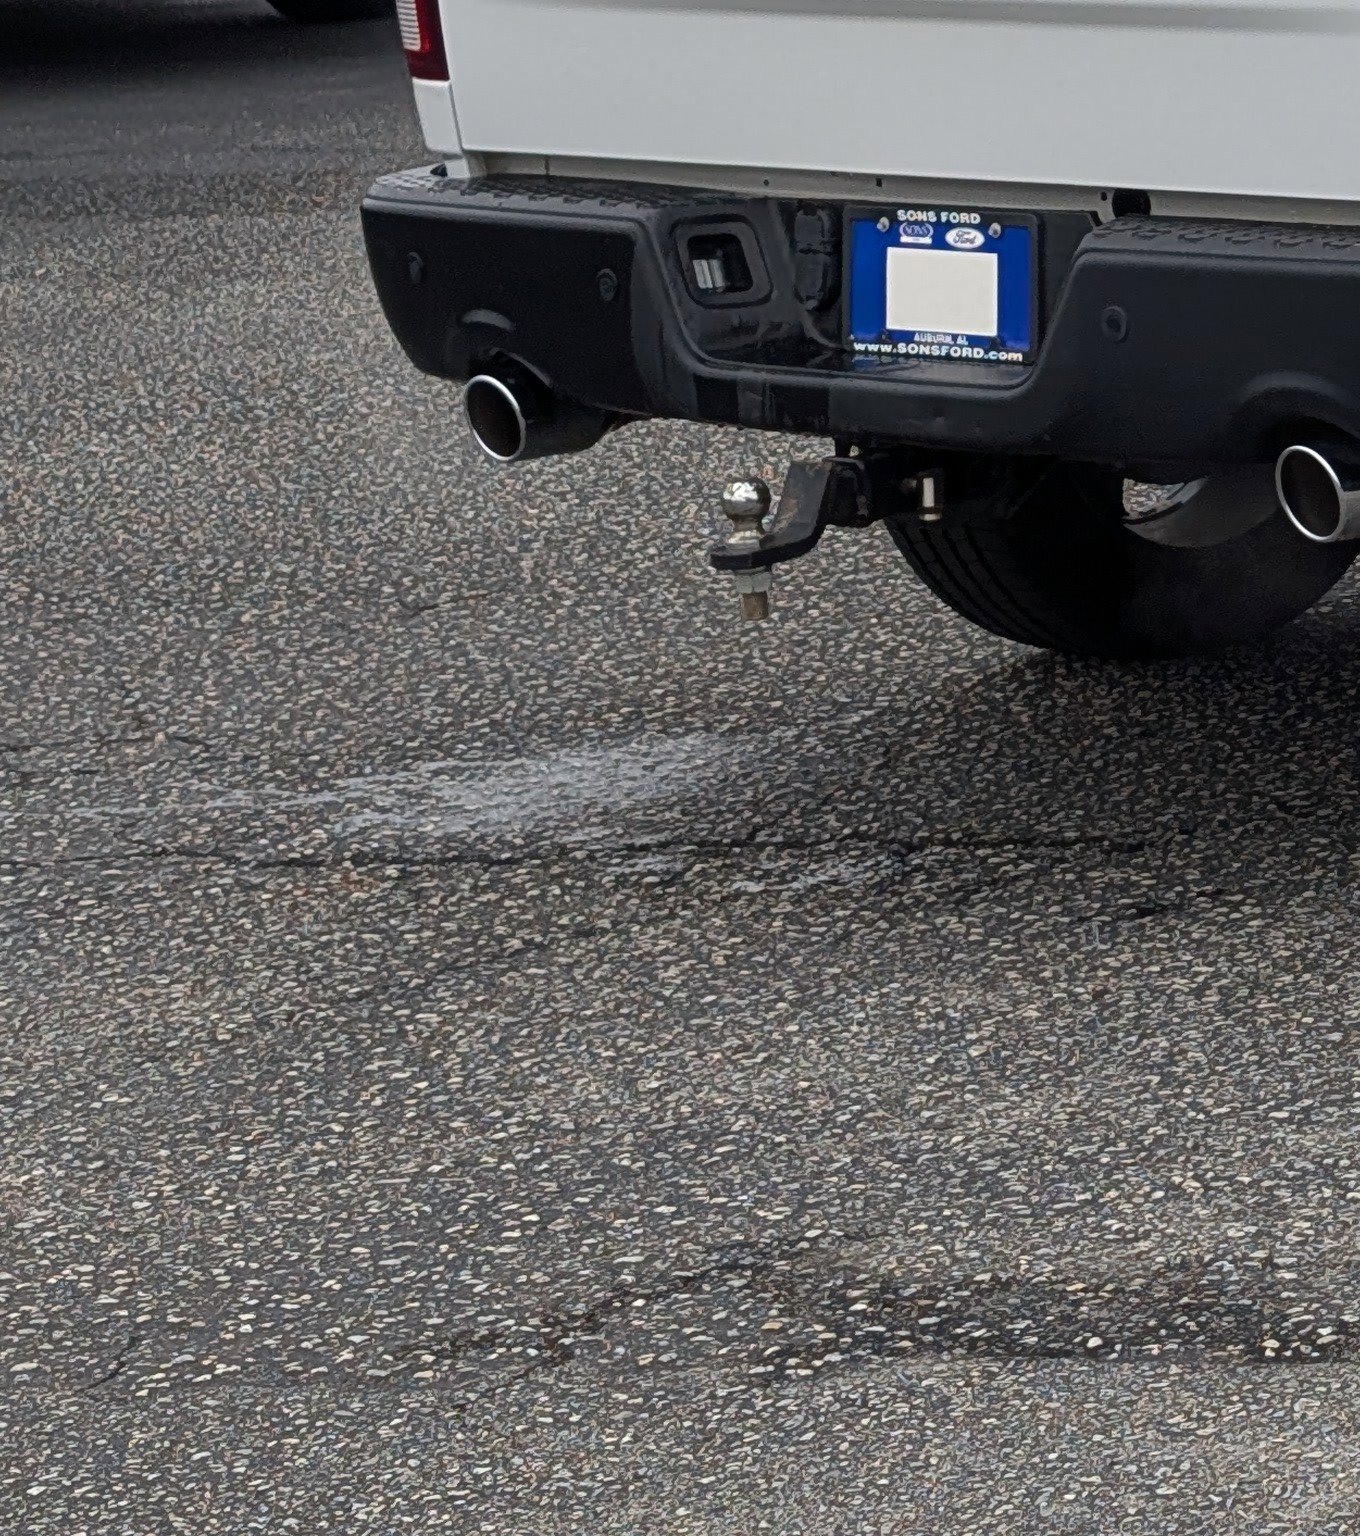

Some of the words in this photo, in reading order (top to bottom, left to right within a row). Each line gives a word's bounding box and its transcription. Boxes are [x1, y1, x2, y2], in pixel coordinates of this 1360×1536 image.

[896, 209, 937, 223] SONS
[940, 211, 981, 224] FORD
[853, 341, 1024, 362] www.SONSFORD.com
